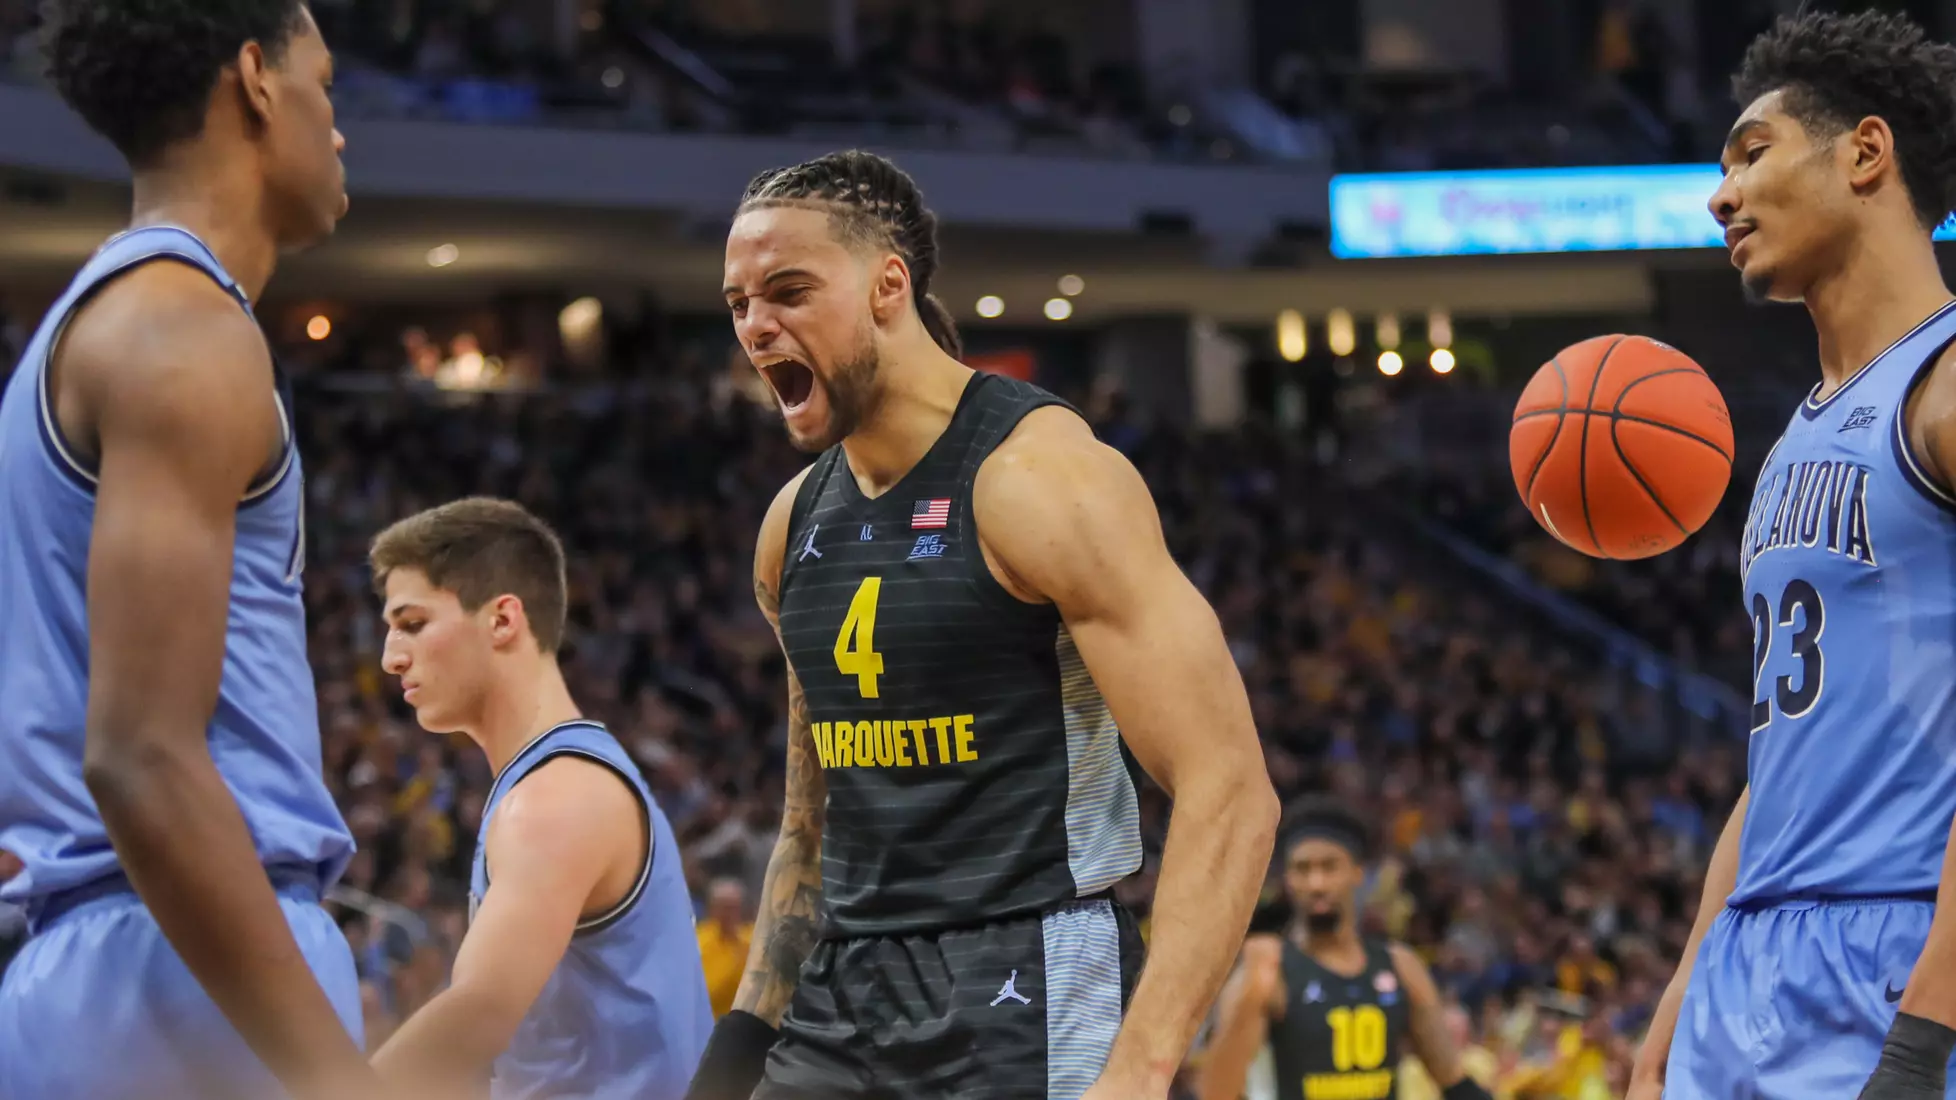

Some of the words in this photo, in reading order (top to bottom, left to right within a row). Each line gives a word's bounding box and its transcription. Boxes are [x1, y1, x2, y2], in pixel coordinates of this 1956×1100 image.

[1851, 406, 1877, 418] BIG
[1843, 416, 1878, 429] EAST
[916, 534, 942, 546] BIG
[910, 545, 948, 556] EAST
[833, 576, 884, 698] 4
[1751, 578, 1825, 734] 23
[1326, 1004, 1388, 1072] 10
